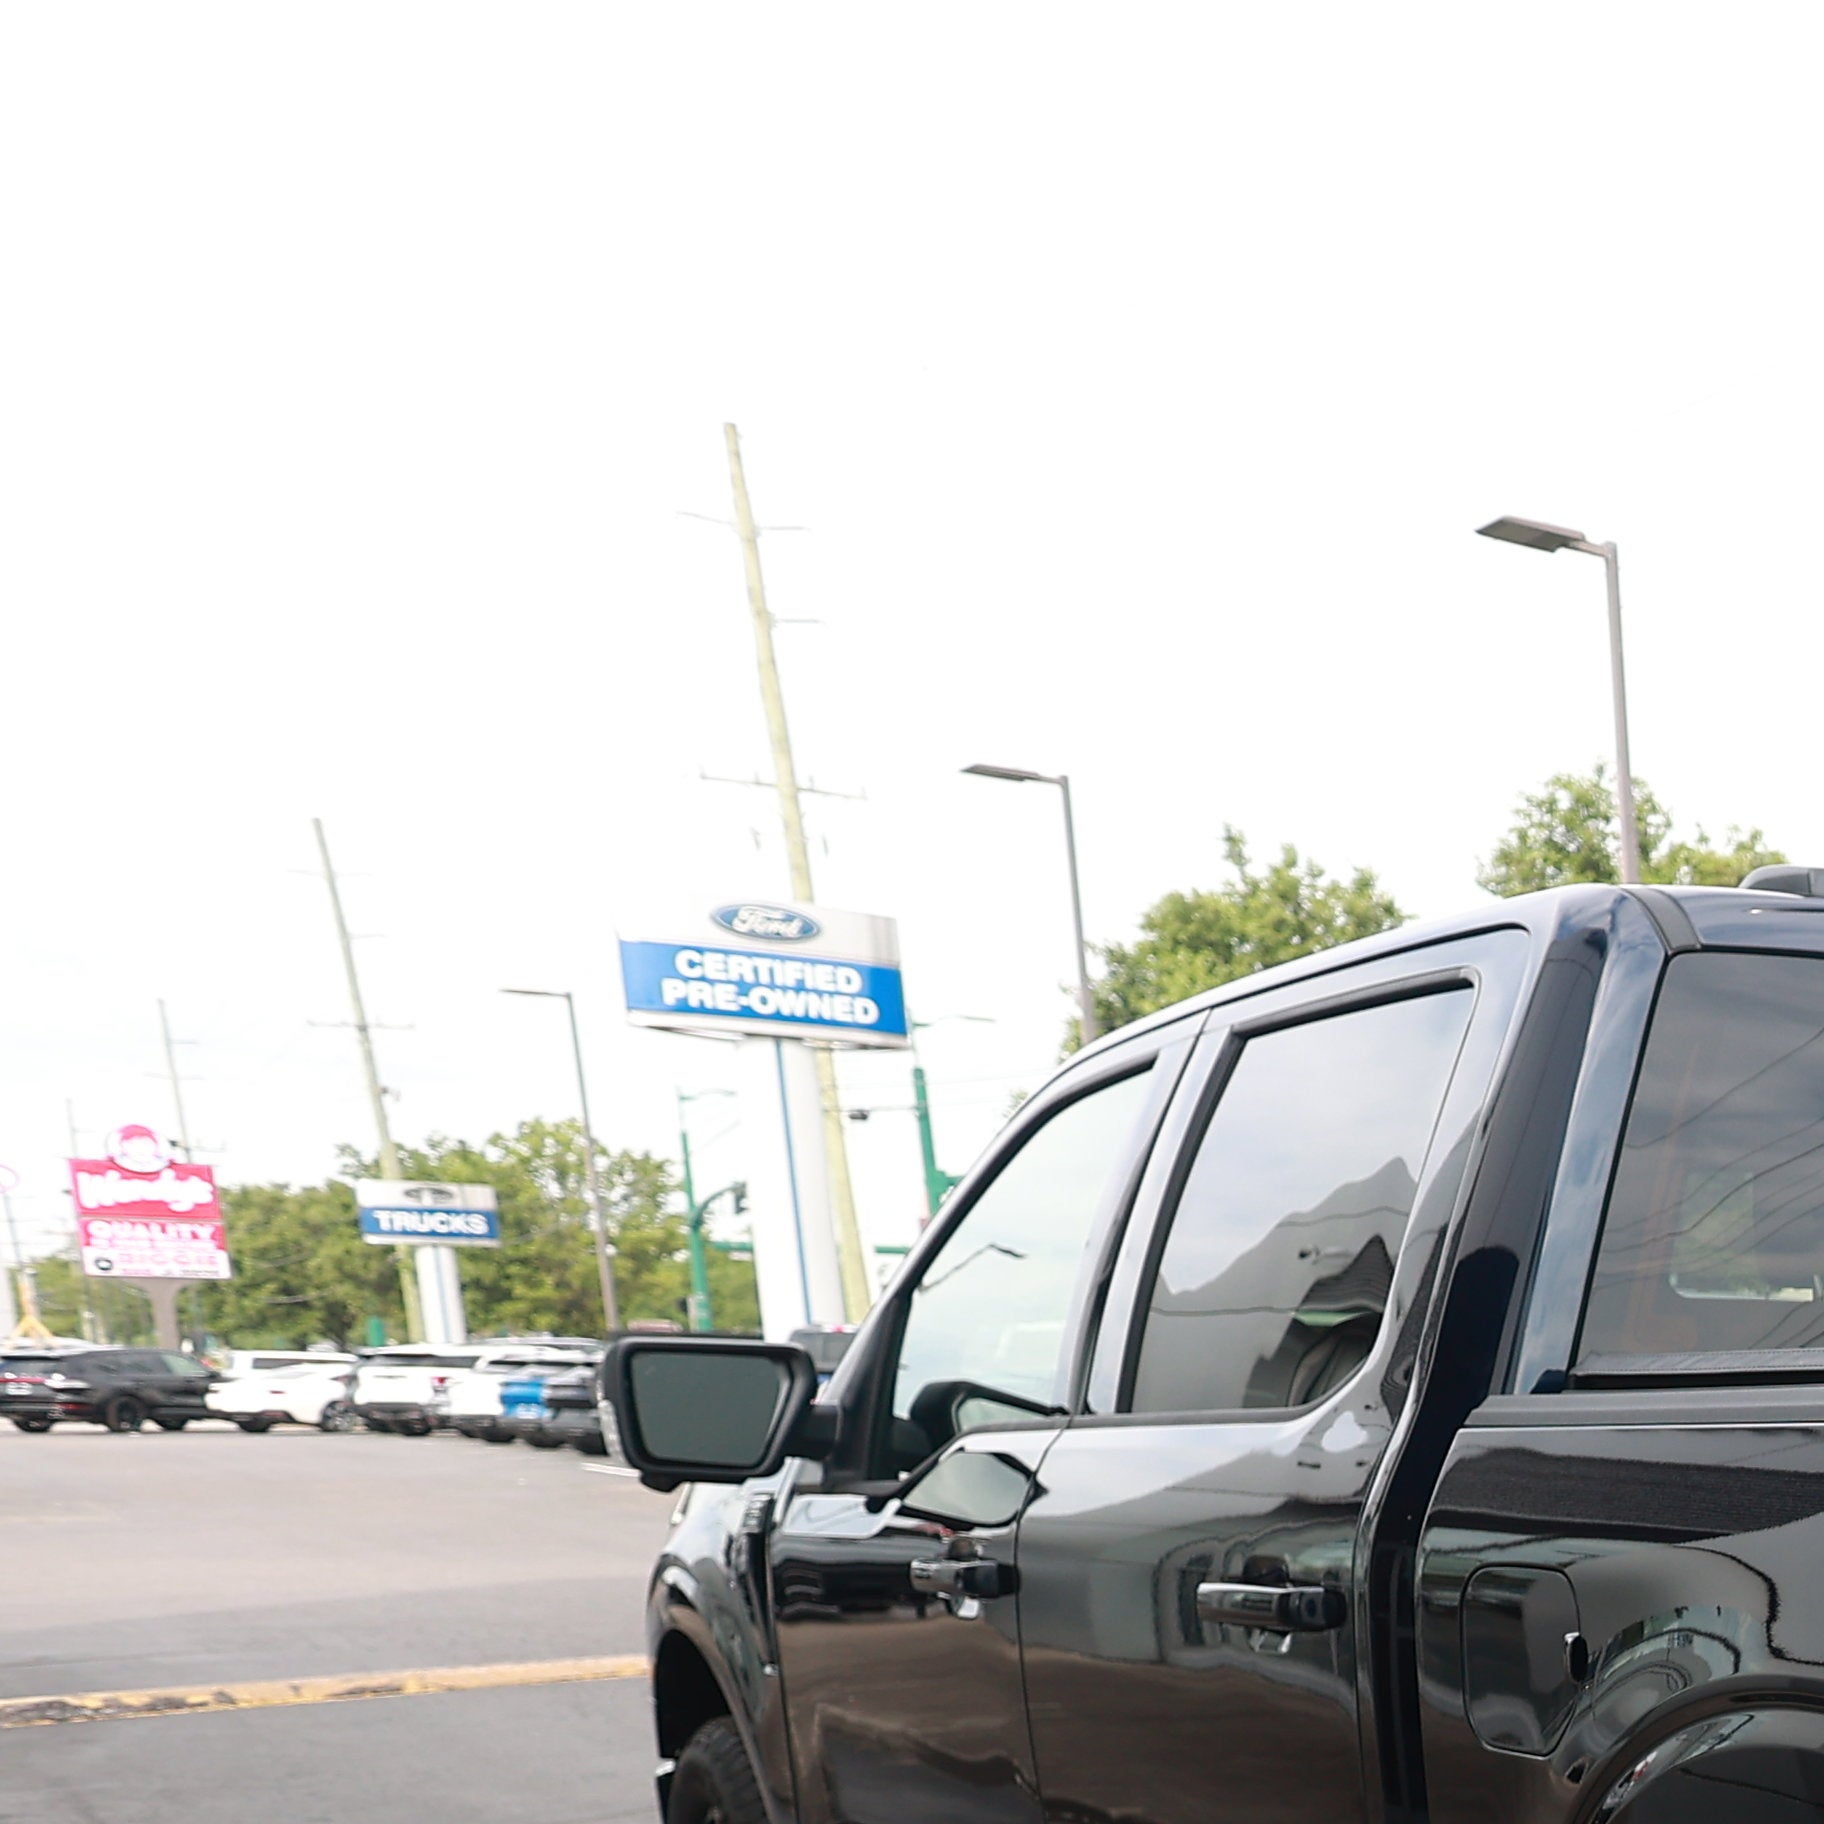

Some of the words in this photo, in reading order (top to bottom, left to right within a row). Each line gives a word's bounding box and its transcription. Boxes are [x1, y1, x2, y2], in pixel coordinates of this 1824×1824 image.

[731, 905, 803, 937] Ford
[674, 948, 864, 995] CERTIFIED
[660, 977, 881, 1026] PRE-OWNED
[87, 1219, 217, 1241] QUALITY
[371, 1209, 490, 1235] TRUCKS
